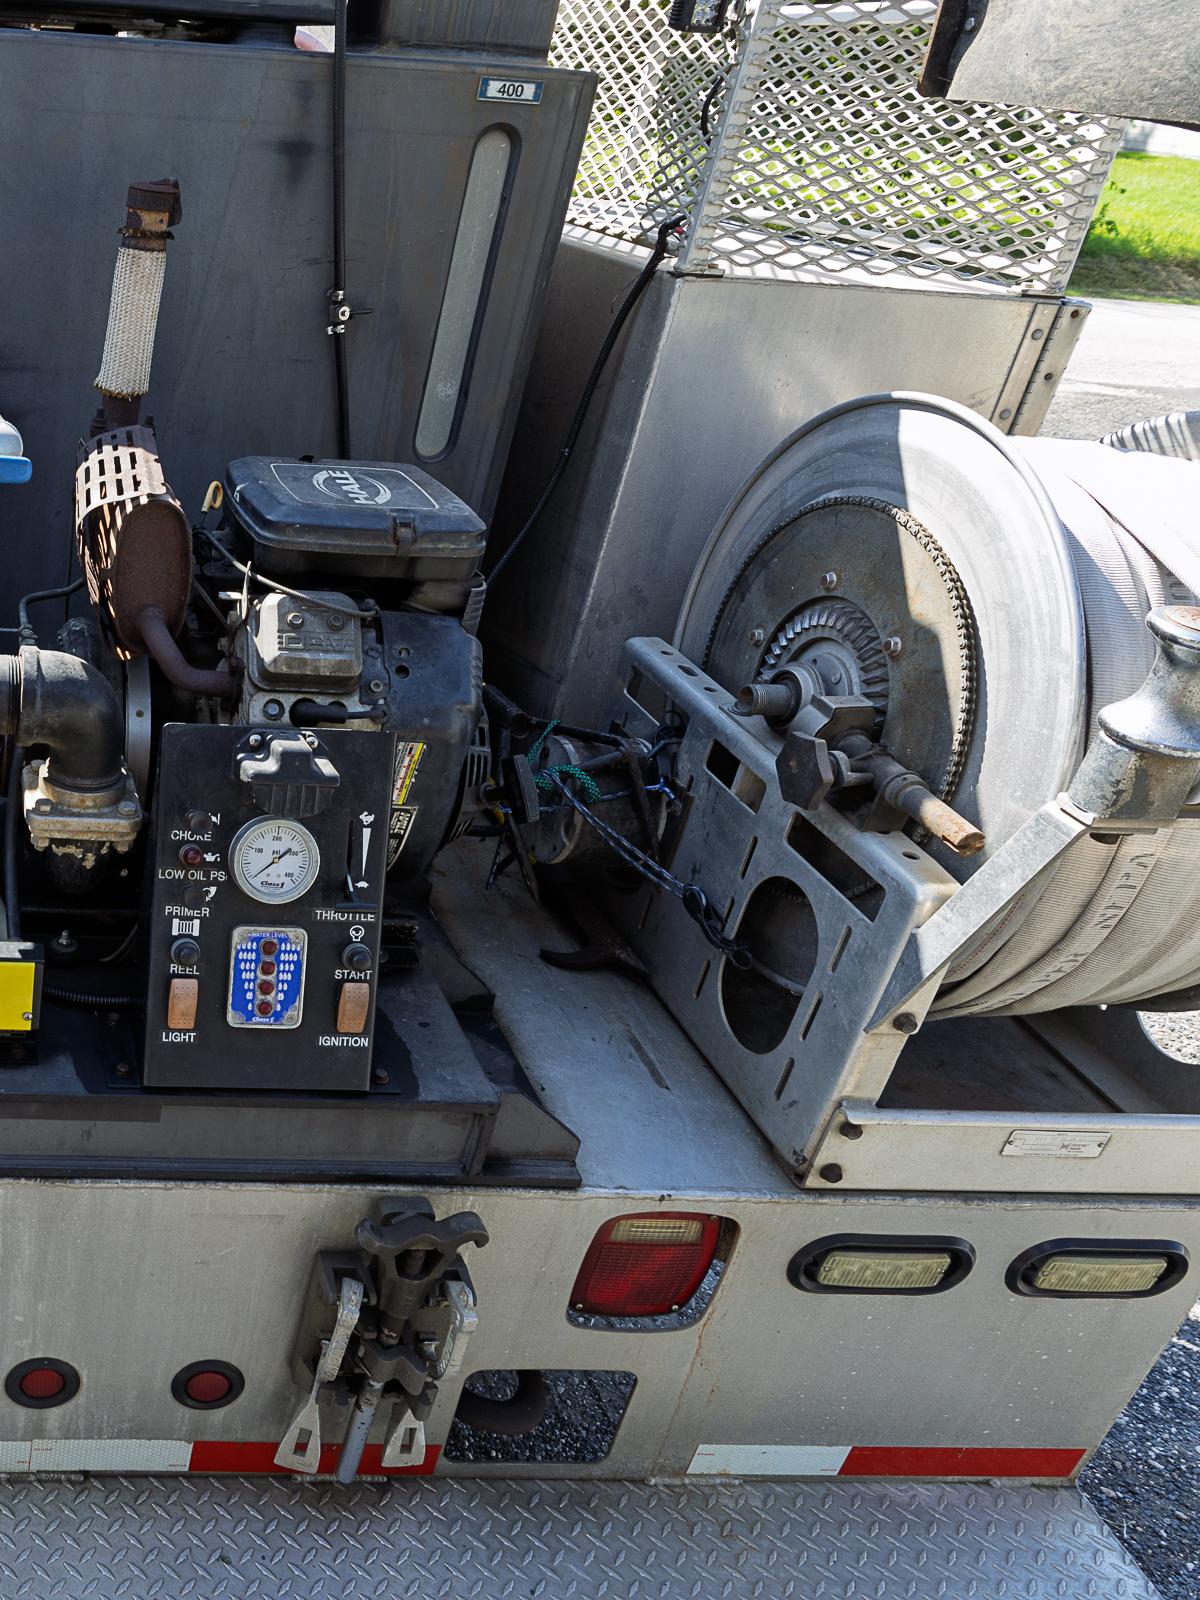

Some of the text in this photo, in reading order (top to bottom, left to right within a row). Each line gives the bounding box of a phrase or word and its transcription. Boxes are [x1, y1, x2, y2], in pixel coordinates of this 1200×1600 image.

[497, 83, 524, 98] 400
[328, 470, 376, 504] HALE
[171, 830, 212, 841] CHOKE
[159, 869, 185, 880] LOW
[188, 870, 206, 880] OIL
[165, 906, 210, 917] PRIMER
[315, 910, 375, 922] THROTTLE
[170, 964, 200, 975] REEL
[334, 970, 372, 980] START
[162, 1032, 196, 1042] LIGHT
[318, 1036, 369, 1047] IGNITION
